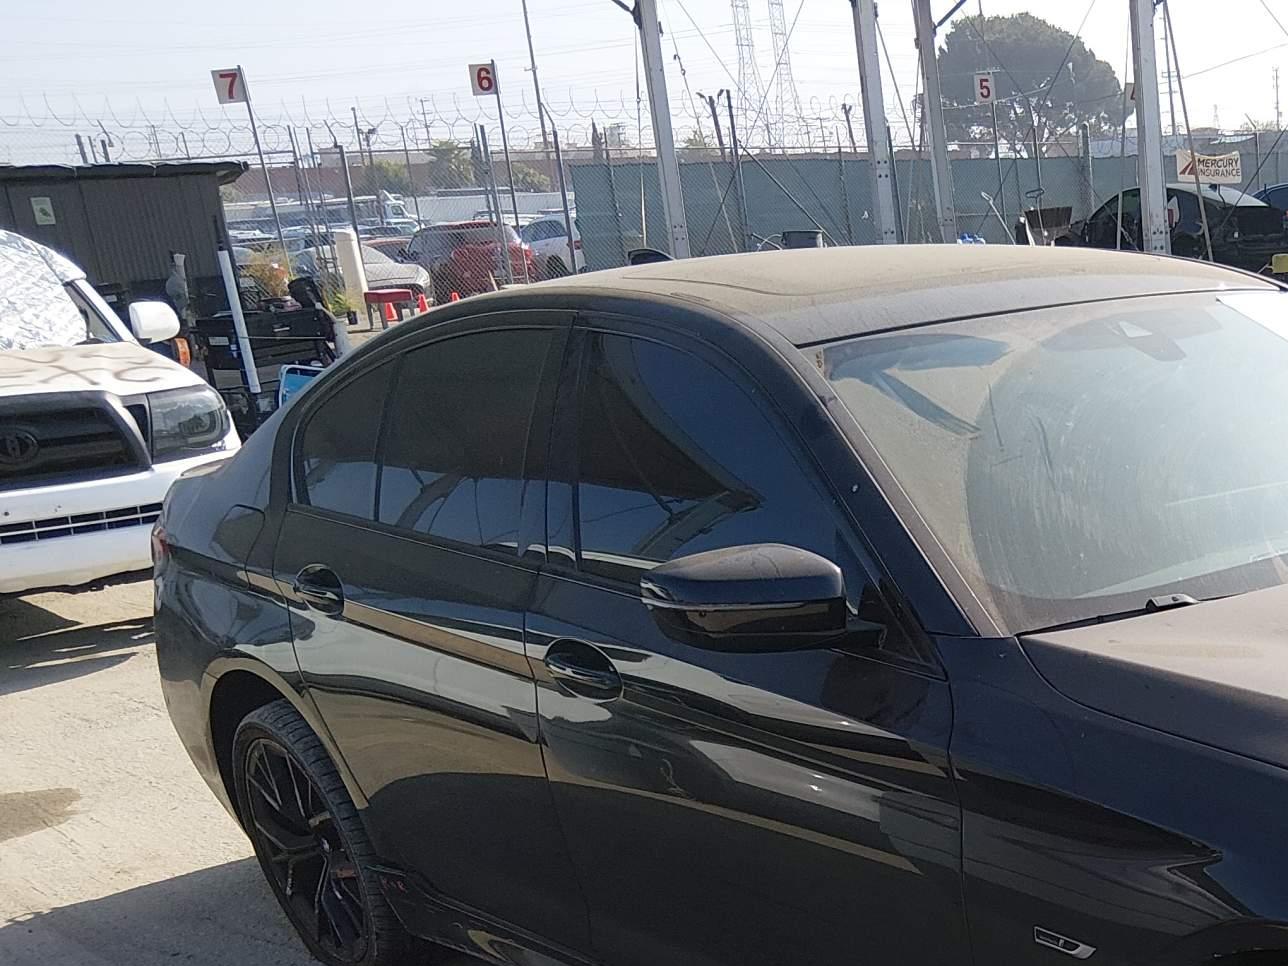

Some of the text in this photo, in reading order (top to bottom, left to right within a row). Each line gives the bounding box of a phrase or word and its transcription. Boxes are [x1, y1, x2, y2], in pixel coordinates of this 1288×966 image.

[219, 73, 237, 99] 7
[477, 67, 493, 91] 6
[980, 79, 990, 98] 5
[1197, 158, 1239, 168] MERCURY
[1197, 168, 1241, 177] INSURANCE
